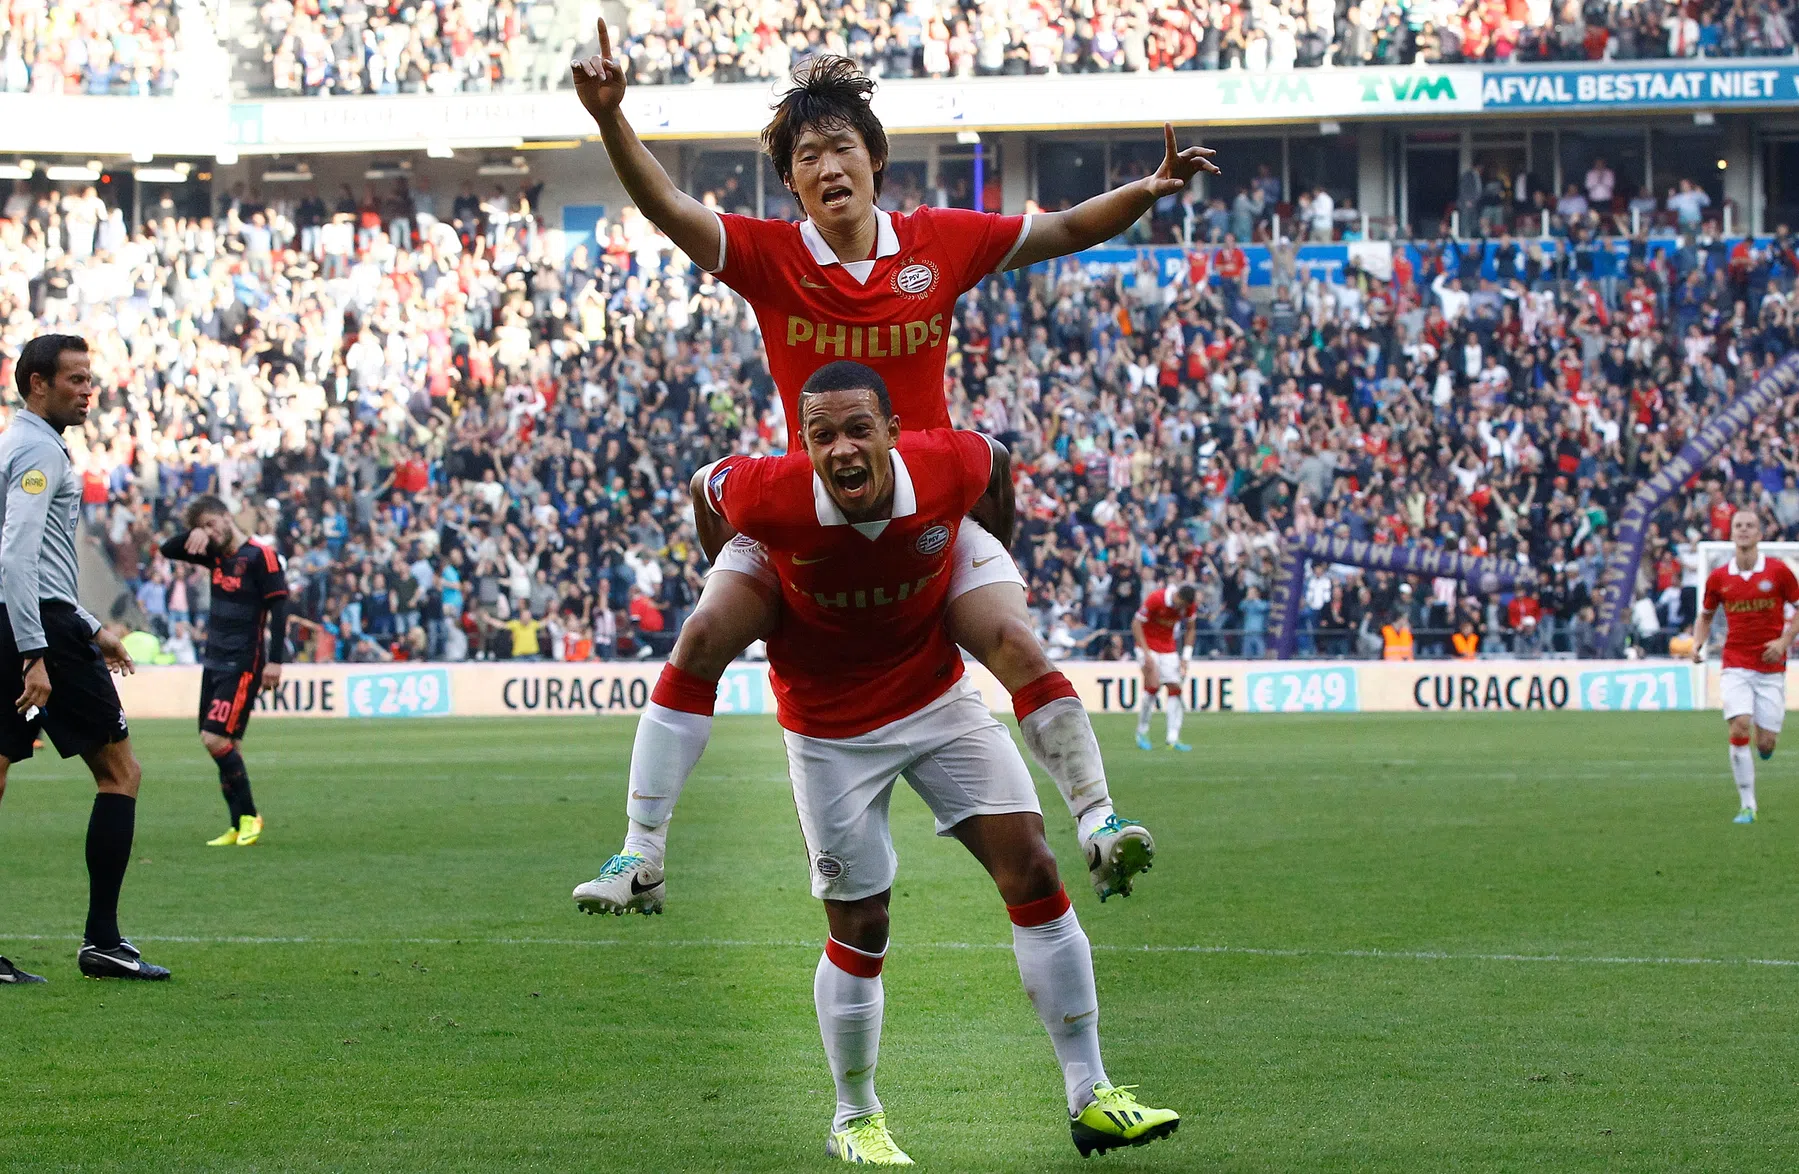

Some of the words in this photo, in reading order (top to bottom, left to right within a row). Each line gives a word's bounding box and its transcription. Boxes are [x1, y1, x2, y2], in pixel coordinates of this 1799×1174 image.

[1358, 75, 1458, 102] TVM
[1484, 76, 1571, 102] AFVAL
[1577, 73, 1704, 100] BESTAAT
[1710, 71, 1778, 97] NIET
[909, 273, 920, 281] PSV
[787, 313, 943, 357] PHILIPS
[928, 534, 939, 543] PSV
[789, 561, 947, 608] HILI
[503, 678, 648, 712] CURAÇAO
[715, 674, 750, 711] 21
[1097, 677, 1234, 711] TUIJE
[207, 699, 232, 723] 20
